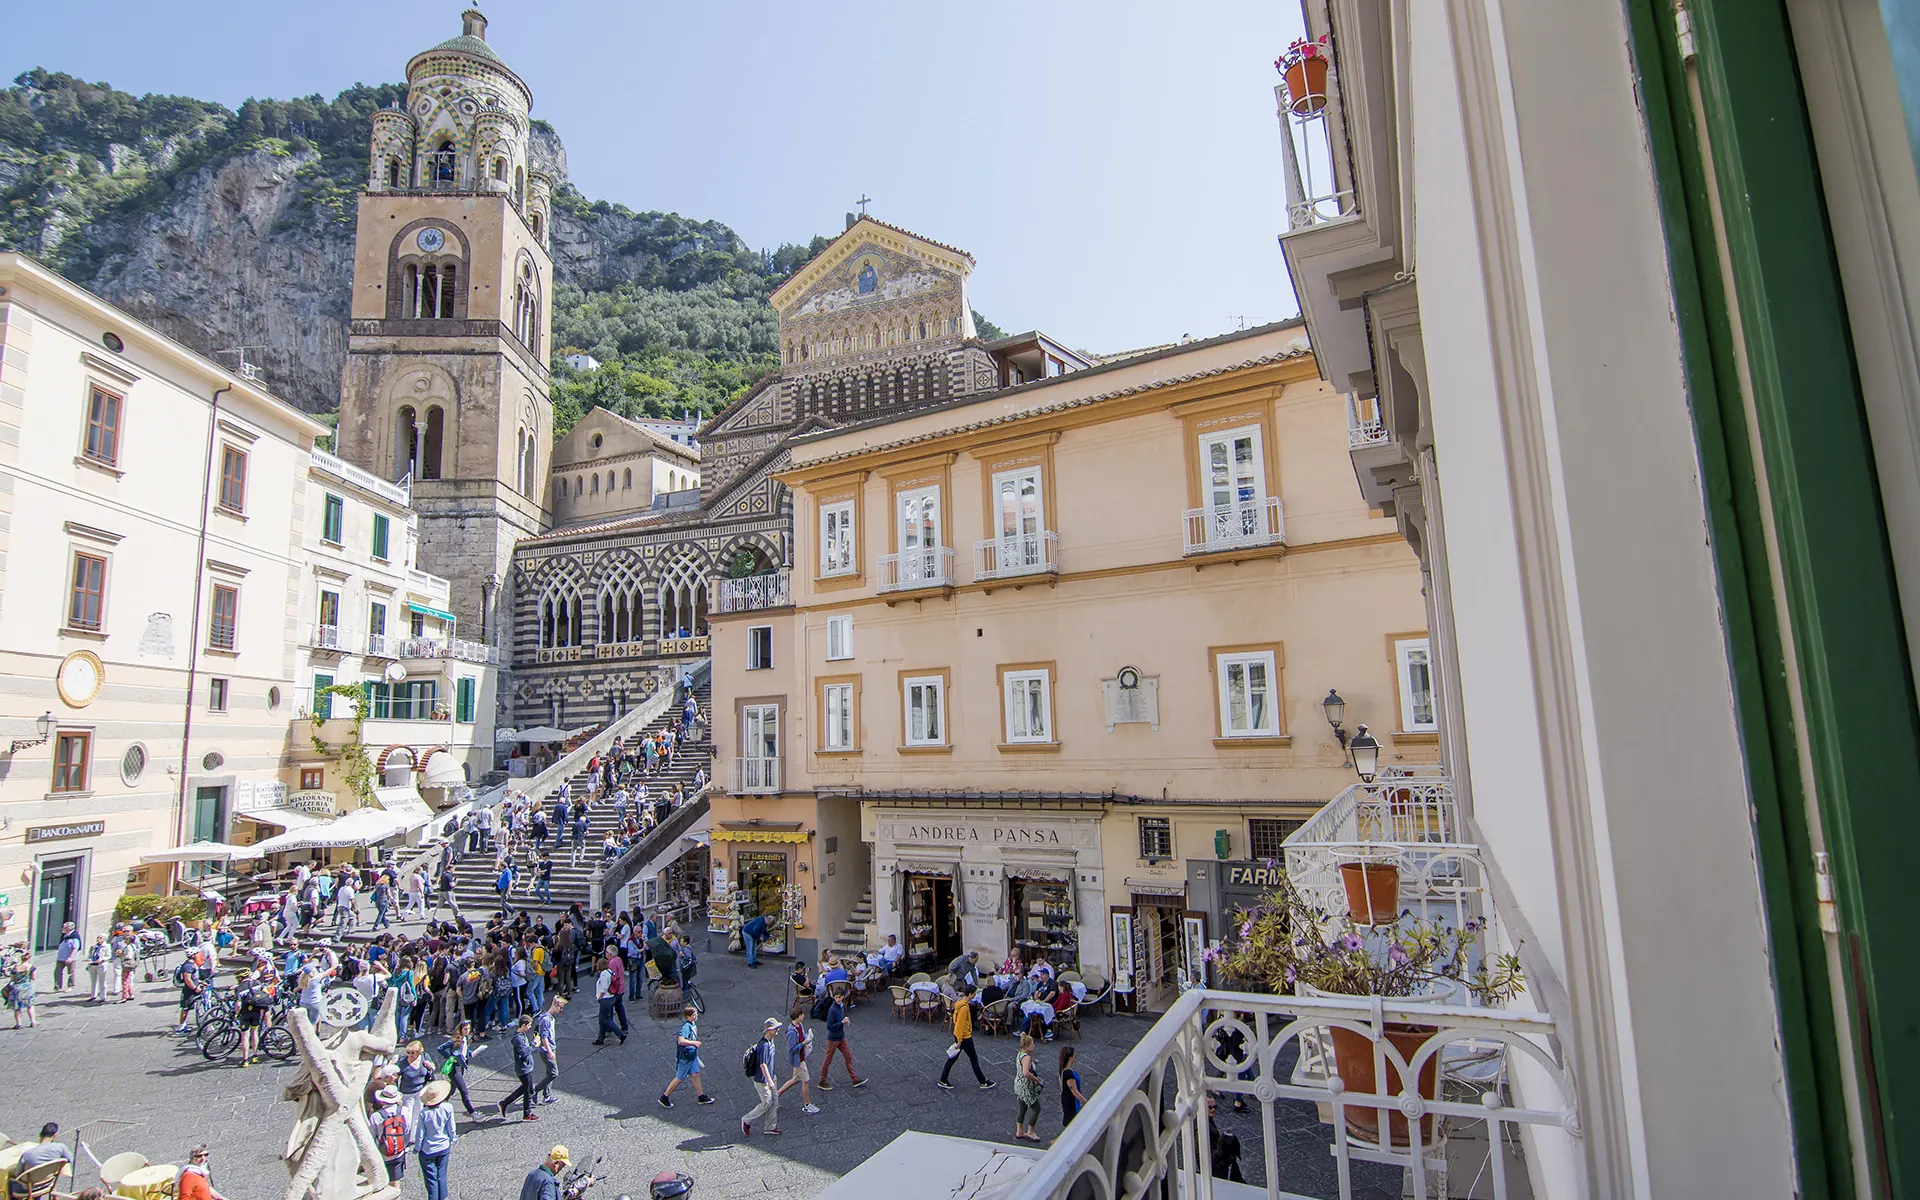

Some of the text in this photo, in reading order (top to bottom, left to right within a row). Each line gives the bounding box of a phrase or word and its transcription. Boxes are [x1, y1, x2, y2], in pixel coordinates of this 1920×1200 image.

[256, 785, 286, 793] RISTORANTE
[260, 791, 283, 799] PIZZERIA
[289, 795, 334, 804] RISTORANTE
[302, 806, 331, 814] ANDREA
[41, 827, 69, 838] BANCO
[76, 823, 104, 834] NAPOLI
[909, 826, 1060, 844] ANDREA PANSA
[293, 841, 323, 849] PIZZERIA
[907, 863, 939, 872] Pasticceria
